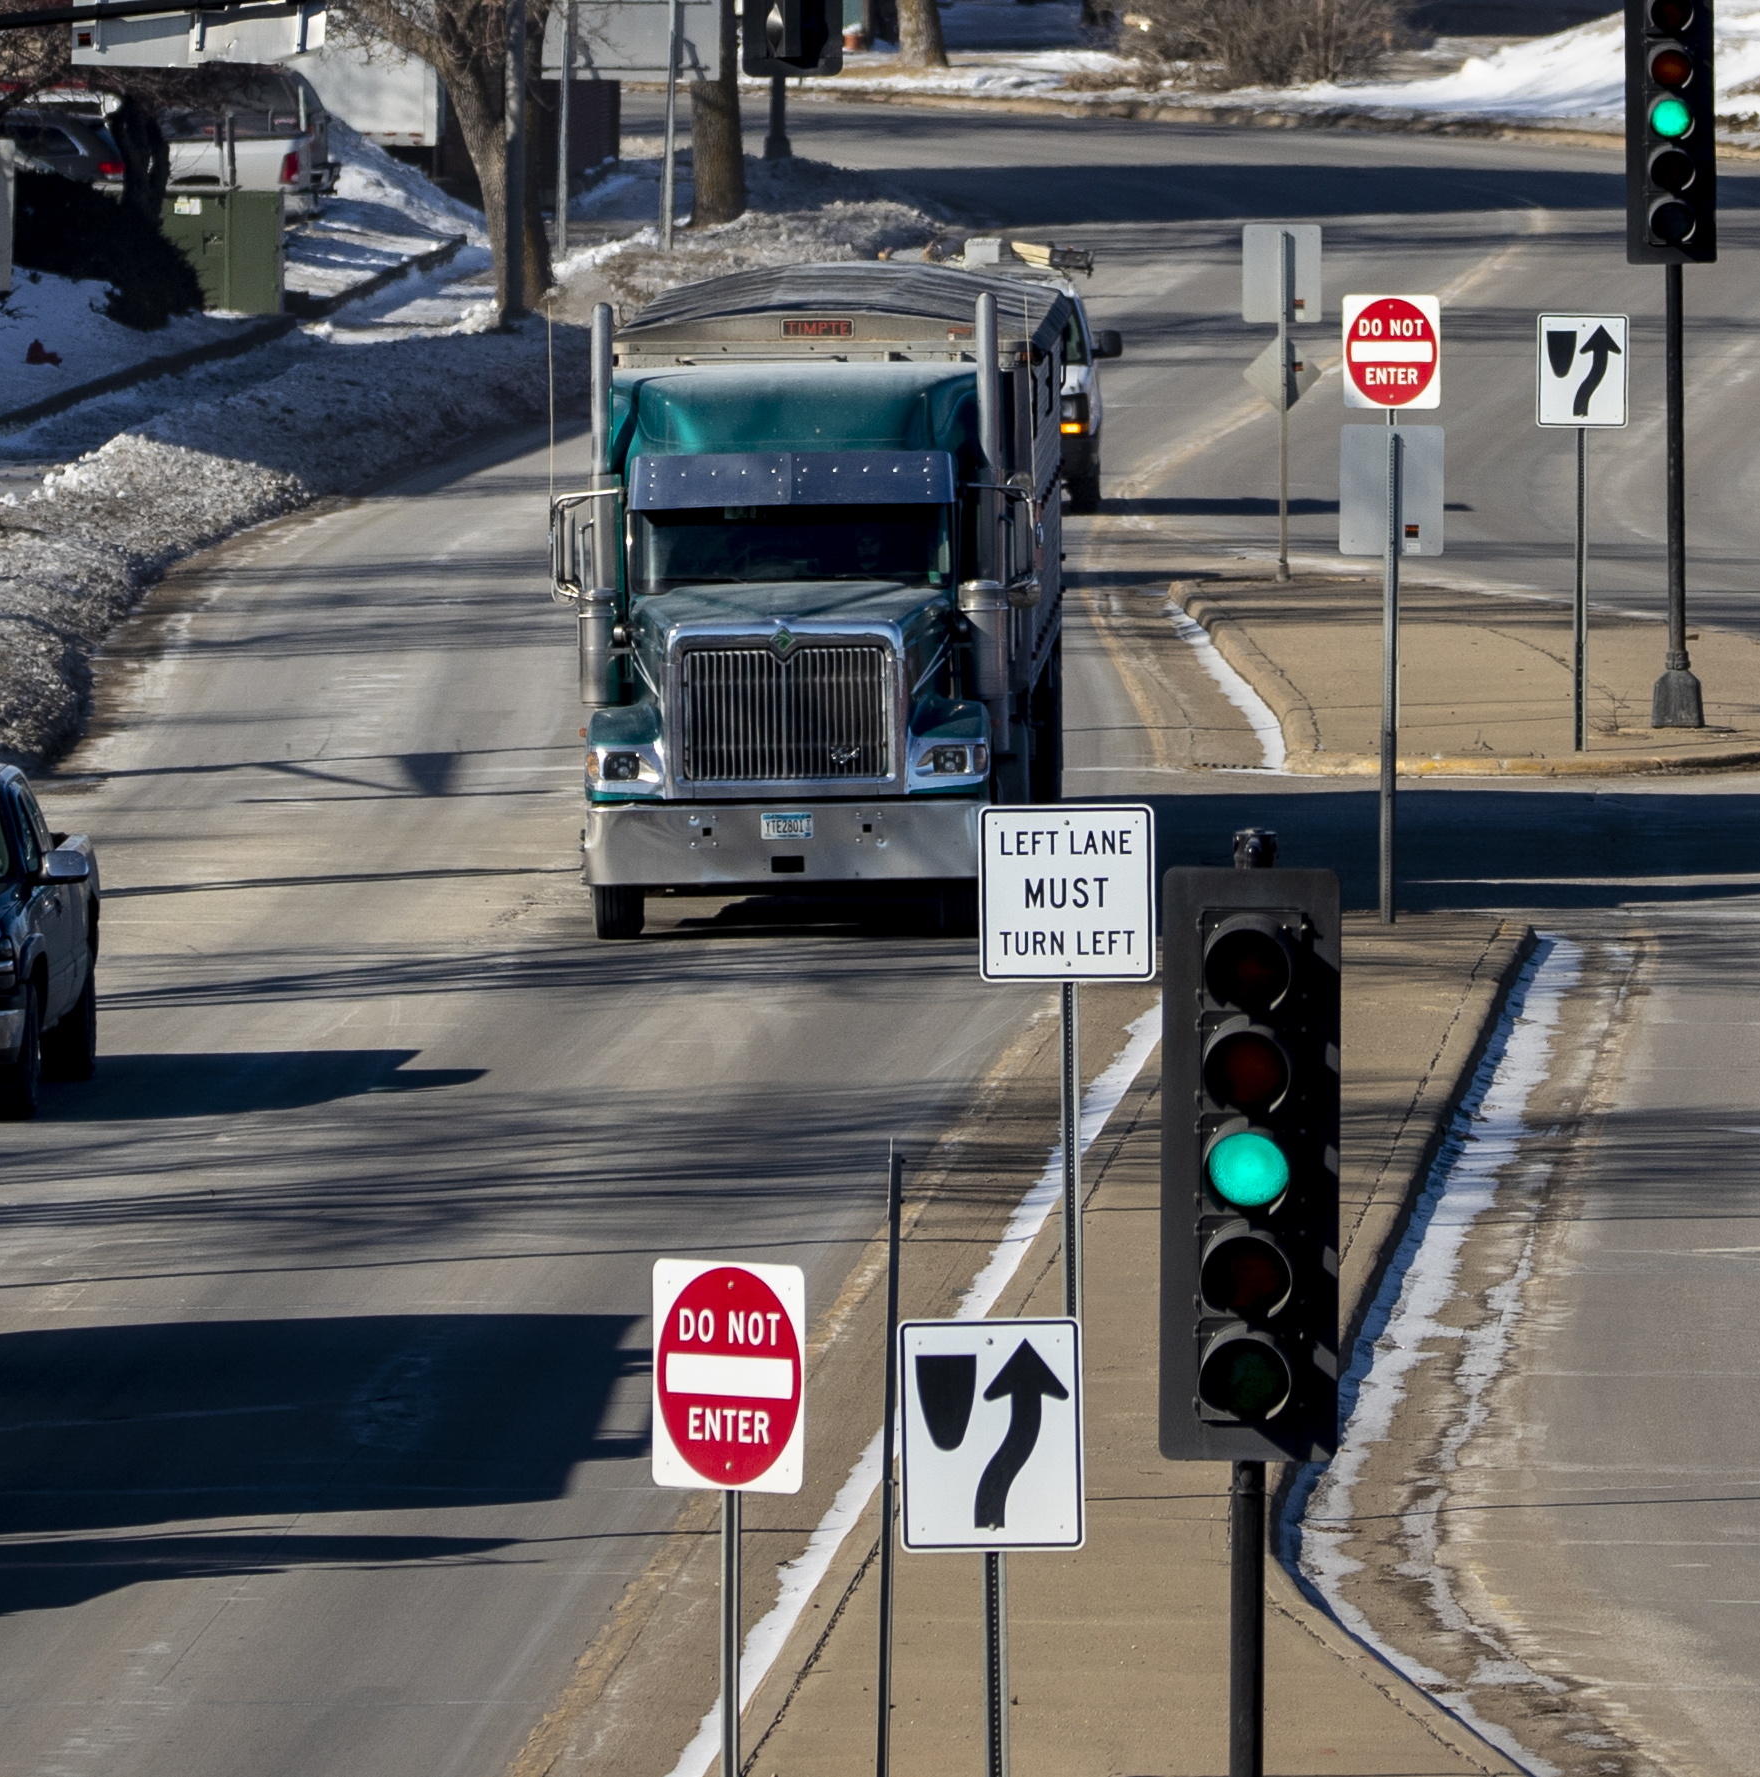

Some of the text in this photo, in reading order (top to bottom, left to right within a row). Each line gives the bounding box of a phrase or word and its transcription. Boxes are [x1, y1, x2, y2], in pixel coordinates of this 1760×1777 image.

[786, 322, 850, 336] TIMPTE
[1359, 318, 1424, 337] DO NOT
[1365, 367, 1418, 385] ENTER
[765, 819, 804, 834] YTE2801
[1000, 830, 1132, 855] LEFT LANE
[1025, 877, 1109, 909] MUST
[999, 930, 1135, 956] TURN LEFT
[679, 1308, 781, 1346] DO NOT
[689, 1407, 770, 1444] ENTER
